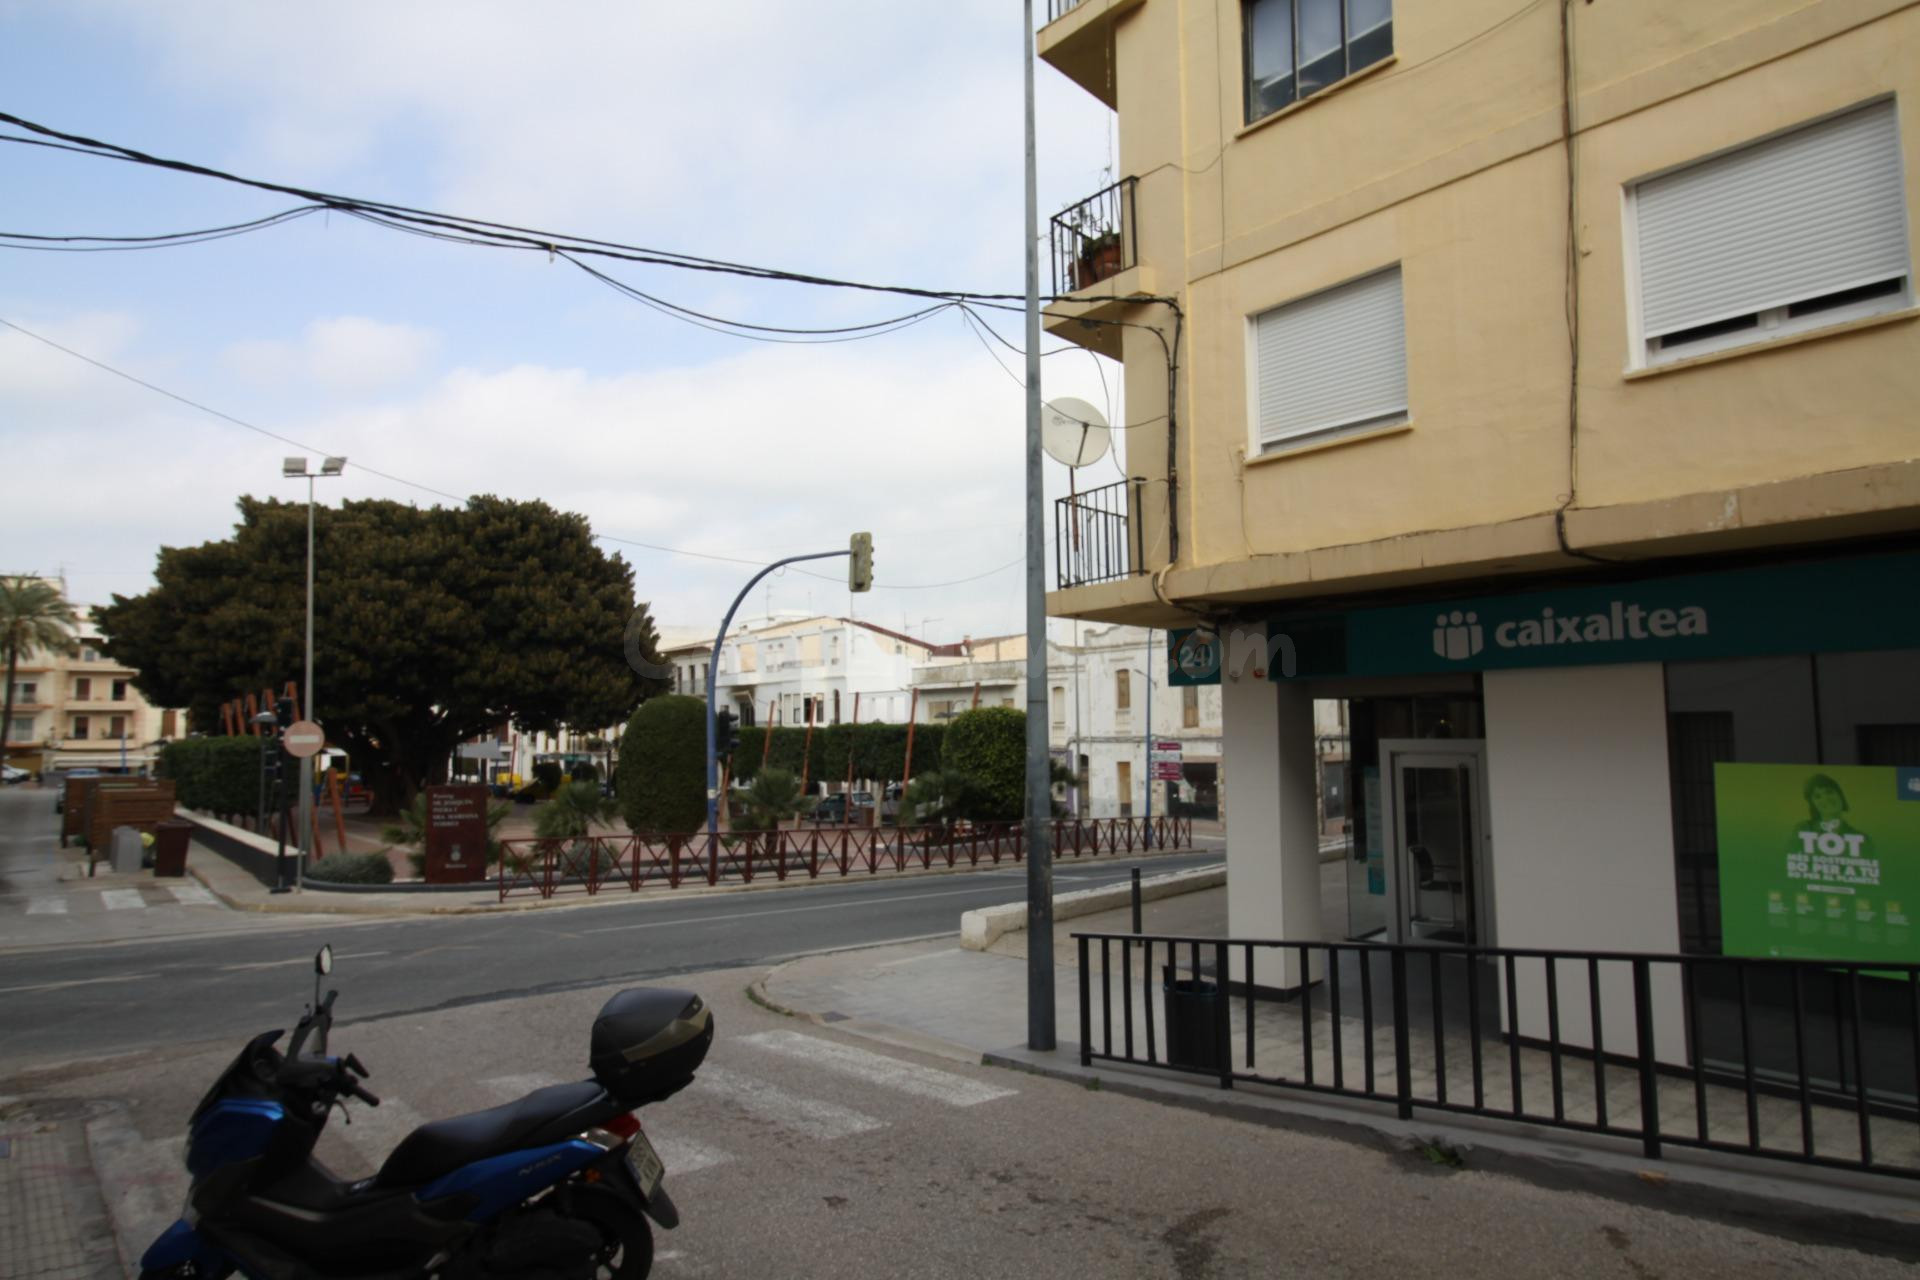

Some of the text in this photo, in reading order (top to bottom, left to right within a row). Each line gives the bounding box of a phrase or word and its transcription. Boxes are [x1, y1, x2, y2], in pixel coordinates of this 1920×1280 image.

[1495, 601, 1708, 648] caixaltea
[1798, 831, 1864, 857] TOT
[1812, 862, 1839, 874] PER
[1844, 865, 1856, 876] A
